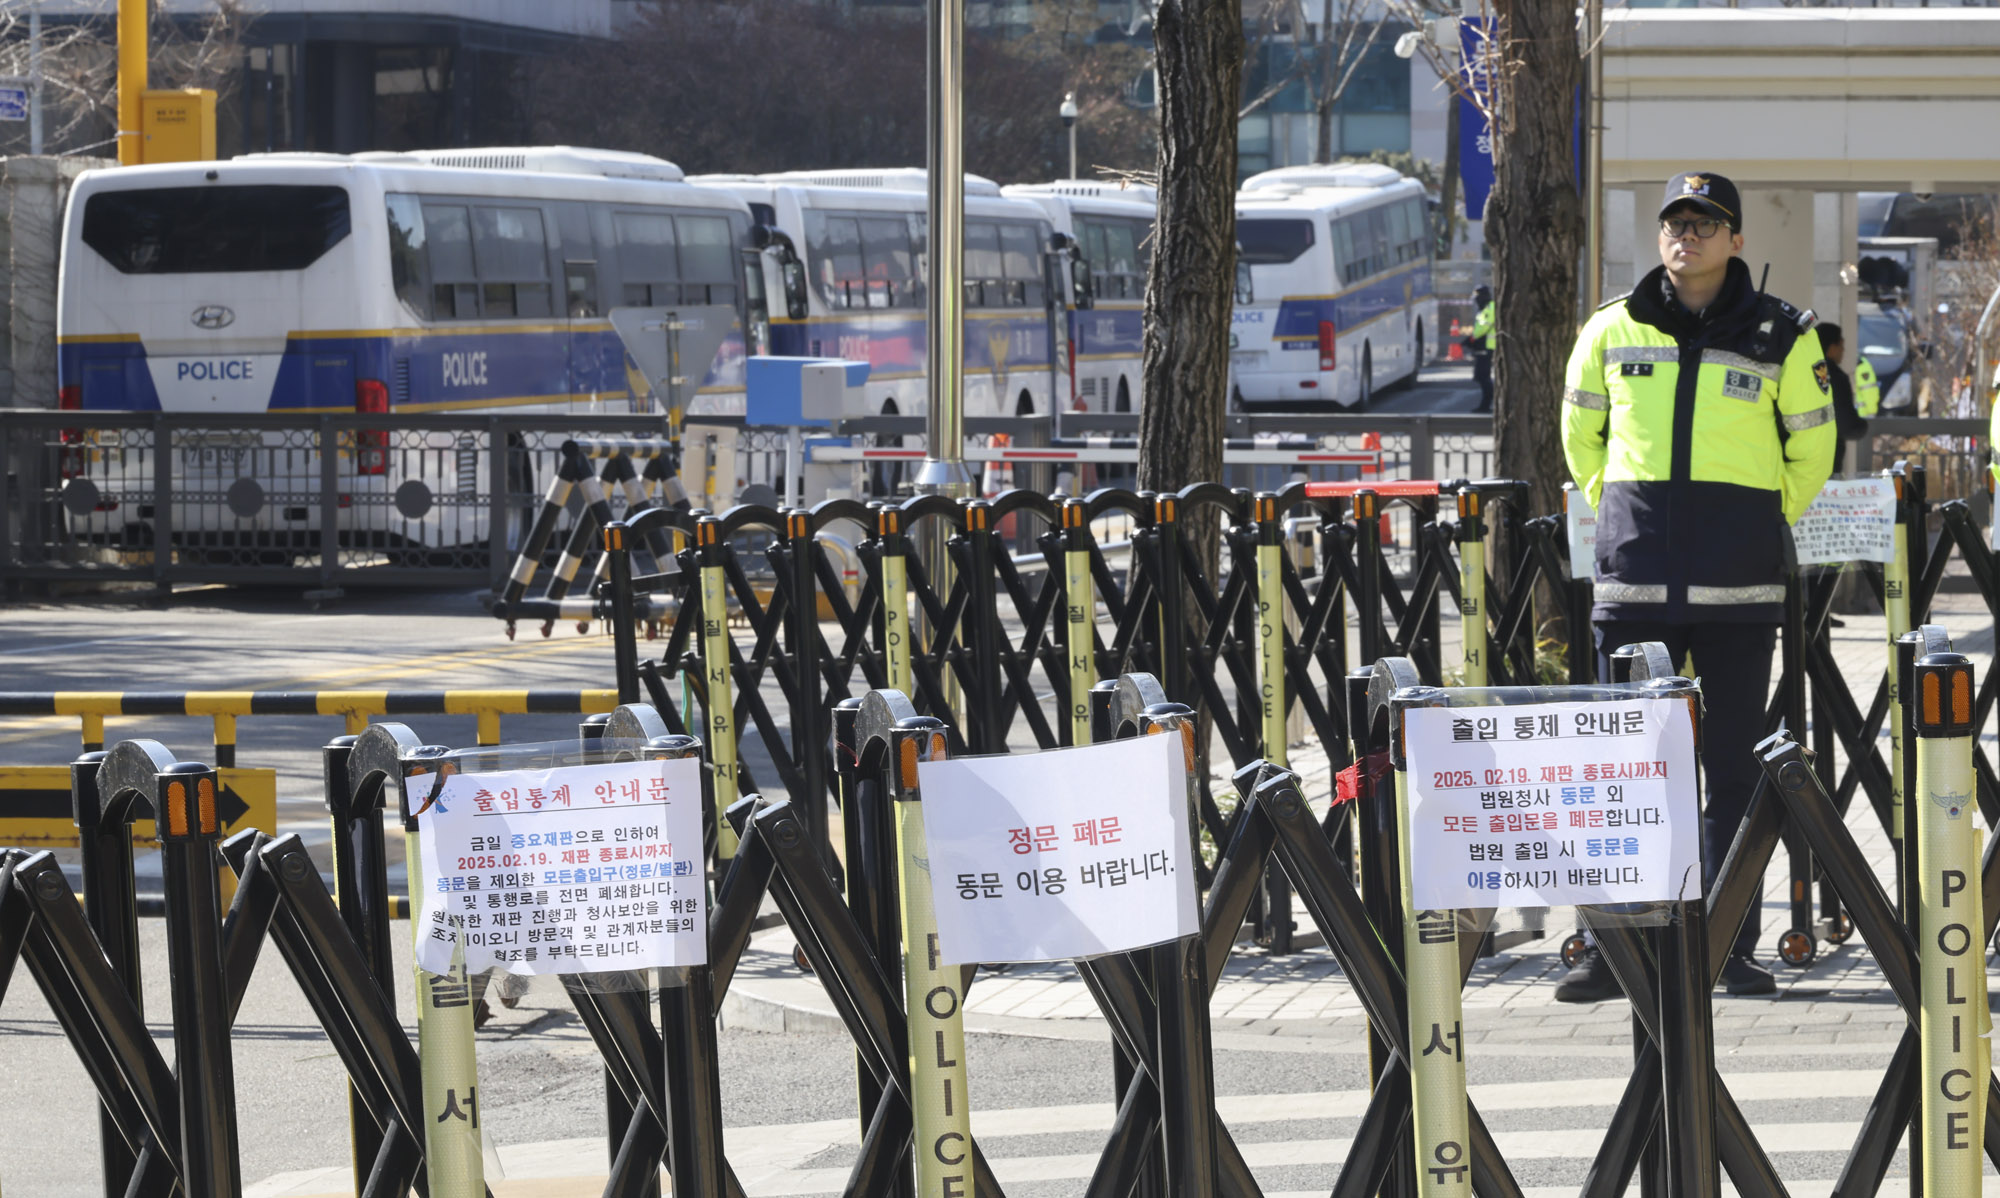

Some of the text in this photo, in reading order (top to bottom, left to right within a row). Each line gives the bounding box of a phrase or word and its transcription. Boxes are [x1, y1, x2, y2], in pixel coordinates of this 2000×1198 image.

[1231, 311, 1265, 323] OLICE
[177, 361, 253, 380] POLICE
[443, 352, 487, 387] POLICE
[1730, 371, 1759, 391] 경찰
[1726, 387, 1757, 400] POLICE
[888, 611, 901, 685] POLI
[1261, 602, 1274, 718] POLICE
[1069, 606, 1089, 722] 질서유
[1452, 710, 1644, 741] 출입 통제 안내문
[1434, 760, 1668, 789] 2025. 02.19. 재판 종료시까지
[473, 777, 670, 812] 출입통제 안내문
[1480, 784, 1624, 810] 법원청사 동문 외
[1443, 807, 1664, 834] 모든 출입문을 폐문합니다.
[470, 825, 659, 851] 금일 중요재판으로 인하여
[1008, 816, 1123, 855] 정문 폐문
[1469, 836, 1640, 861] 법원 출입 시 동문을
[457, 843, 672, 870] 2025.02.19. 재판 종료시까지
[437, 860, 693, 892] 동문을 제외한 모든출입구(정문/별관)
[956, 849, 1175, 901] 동문 이용 바랍니다.
[1467, 866, 1644, 891] 이용하시기 바랍니다.
[463, 881, 678, 910] 및 통행로를 전면 폐쇄합니다.
[492, 911, 522, 927] 재판
[532, 907, 577, 925] 진행과
[587, 900, 660, 921] 청사보안을
[669, 898, 697, 914] 위한
[528, 926, 573, 943] 방문객
[583, 925, 597, 939] 및
[607, 917, 694, 938] 관계자분들의
[494, 940, 645, 962] 협조를 부탁드립니다.
[1937, 869, 1972, 1150] POLICE
